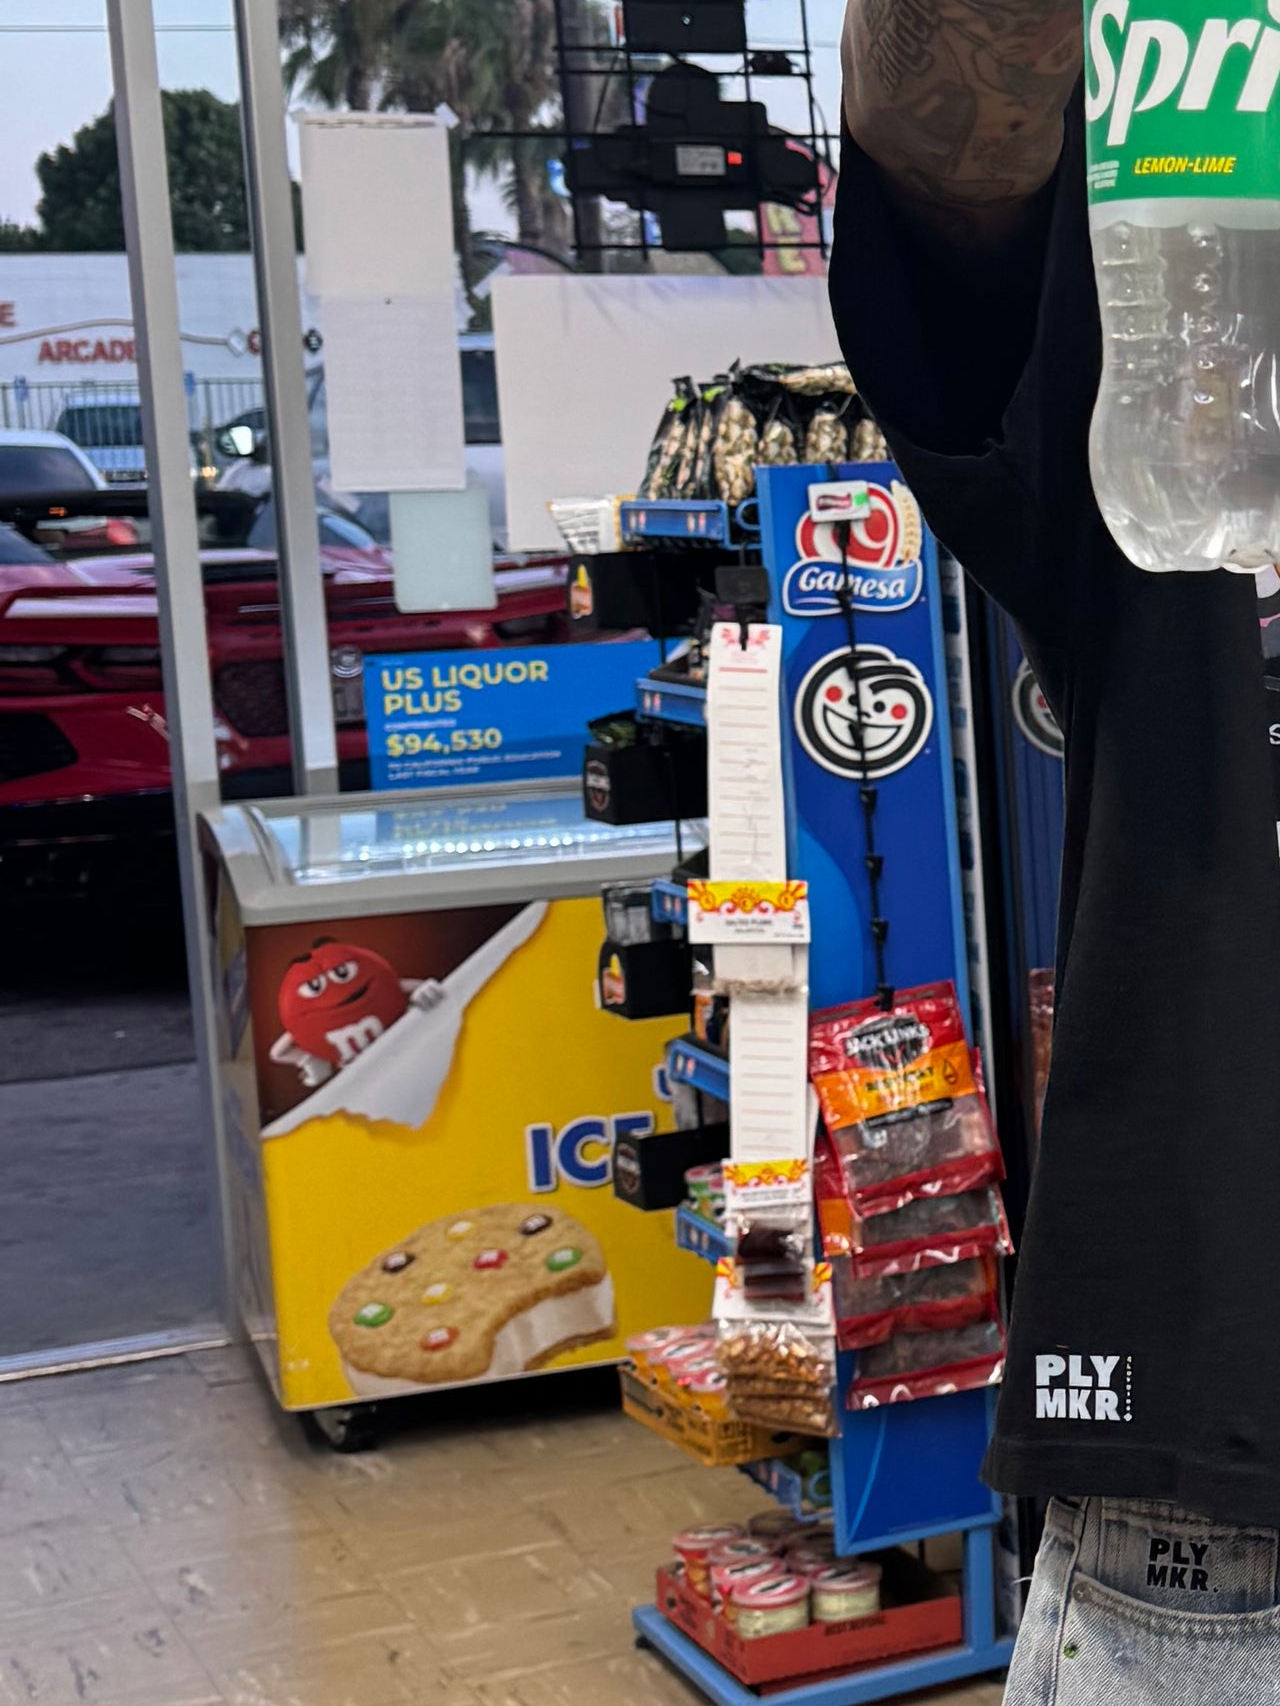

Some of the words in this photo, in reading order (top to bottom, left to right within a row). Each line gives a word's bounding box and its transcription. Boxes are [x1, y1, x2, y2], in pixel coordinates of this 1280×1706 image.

[1133, 155, 1237, 176] LEMON-LIME
[797, 563, 908, 602] Gamesa
[381, 666, 424, 692] US
[431, 659, 550, 690] LIQUOR
[384, 689, 463, 717] PLUS
[386, 727, 503, 759] $94,530
[1035, 1354, 1120, 1388] PLY
[1148, 1537, 1210, 1567] PLY
